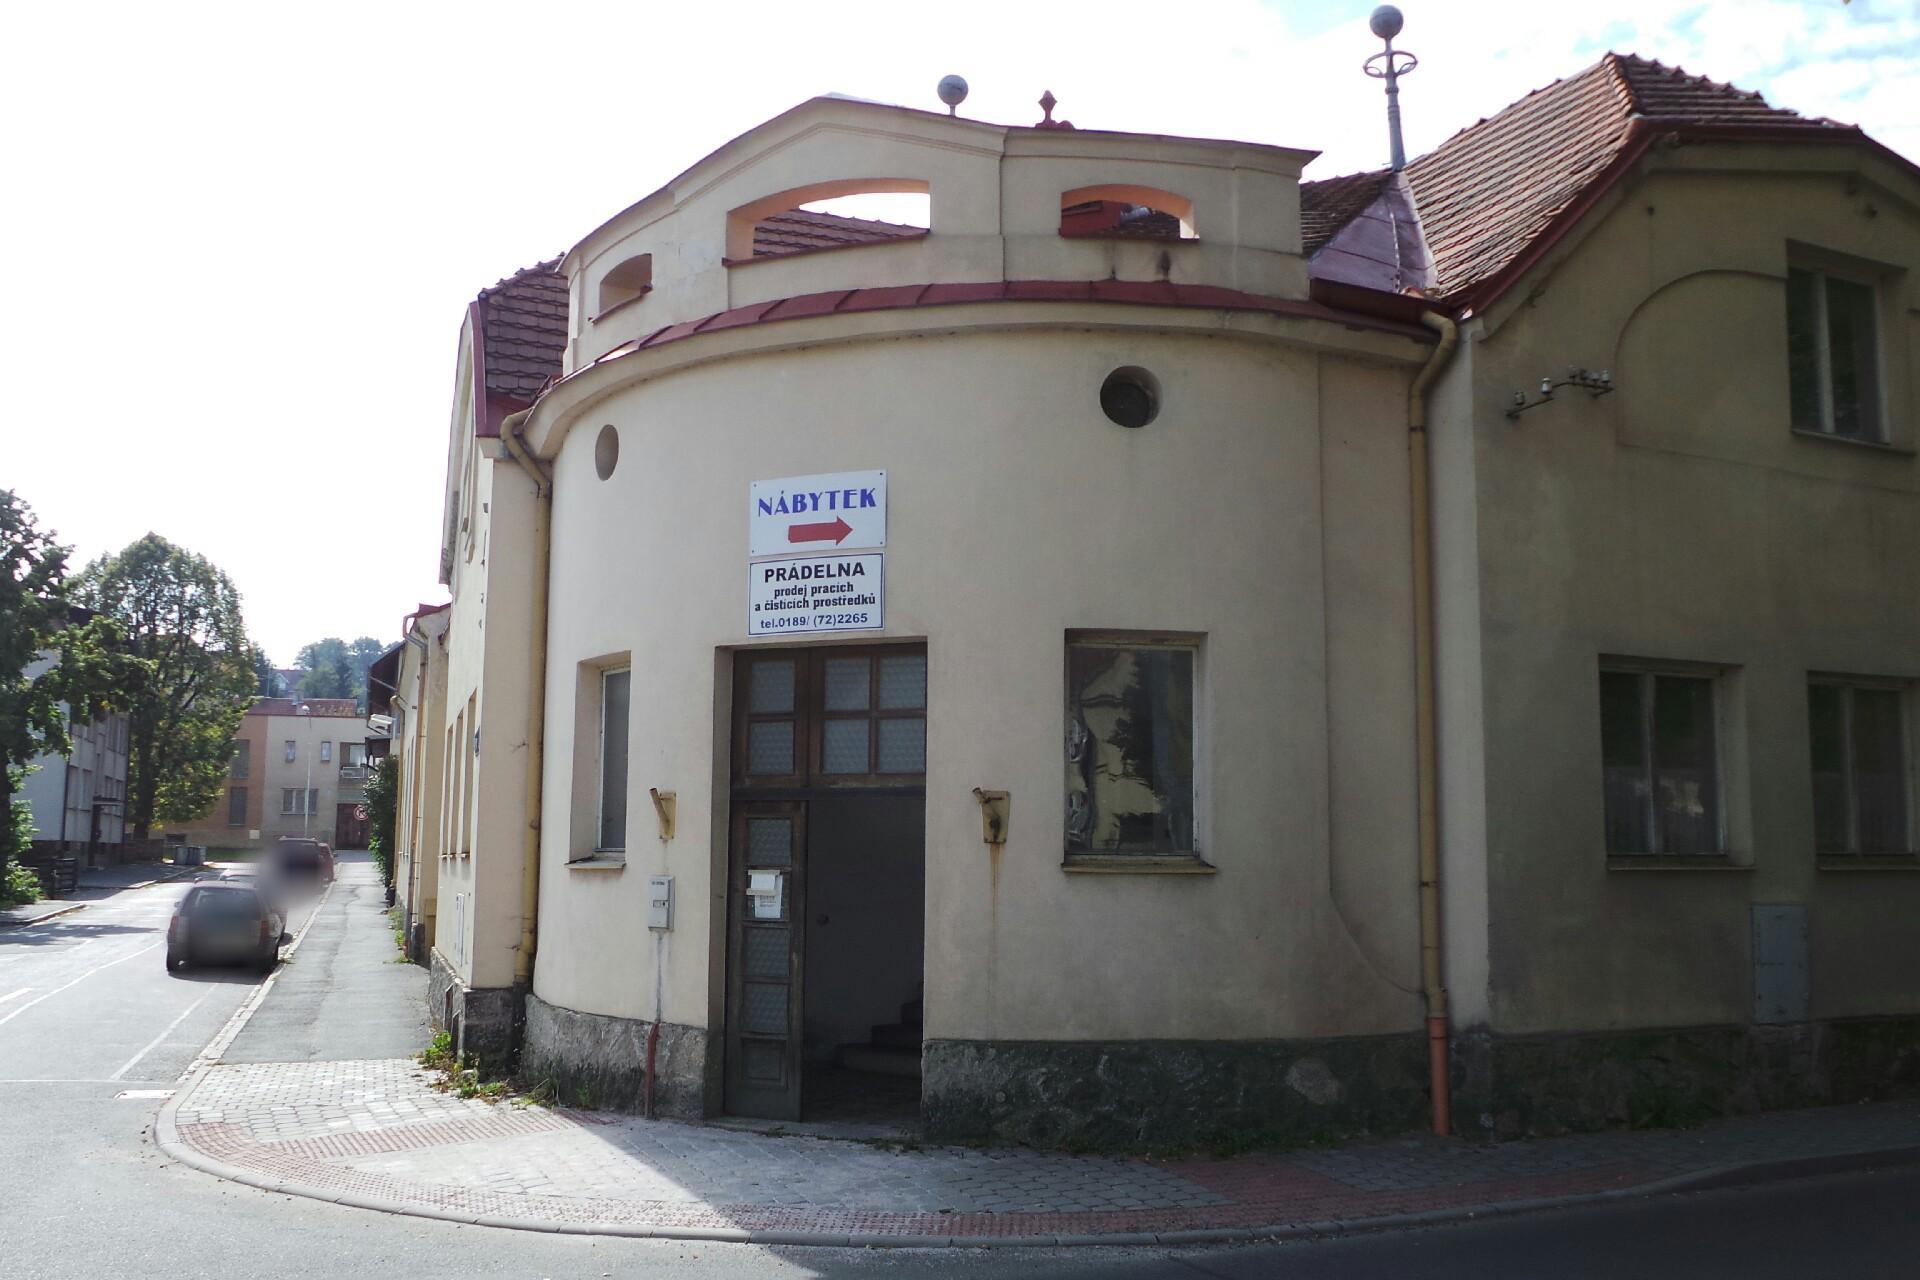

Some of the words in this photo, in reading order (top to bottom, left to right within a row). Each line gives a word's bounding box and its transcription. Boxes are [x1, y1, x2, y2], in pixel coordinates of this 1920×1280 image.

[758, 487, 877, 517] NÁBYTEK
[764, 562, 865, 583] PRÁDELNA
[774, 584, 808, 599] prodej
[754, 603, 761, 612] a
[813, 593, 876, 610] prostředků
[813, 612, 868, 627] (72)2265
